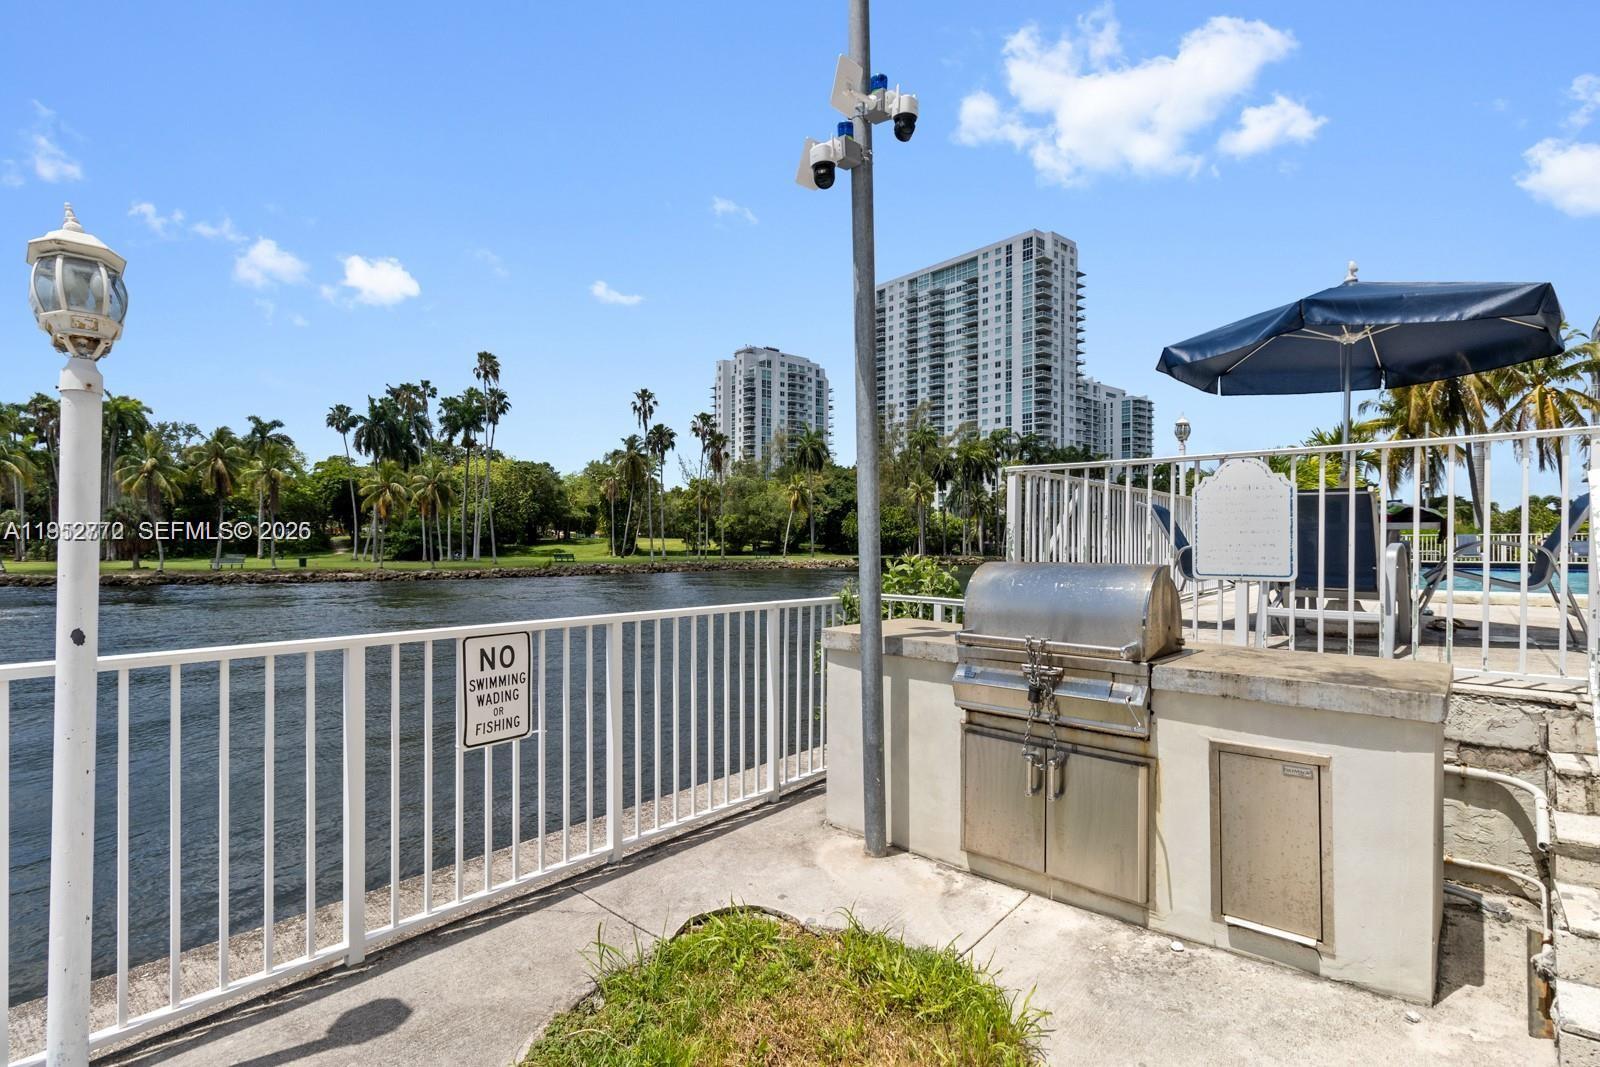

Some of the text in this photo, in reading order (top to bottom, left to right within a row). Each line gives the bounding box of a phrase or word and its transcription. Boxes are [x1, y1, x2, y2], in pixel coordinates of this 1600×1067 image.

[480, 645, 515, 672] NO
[469, 672, 526, 692] SWIMMING
[476, 688, 519, 707] WADING
[493, 706, 504, 717] OR
[475, 715, 520, 736] FISHING
